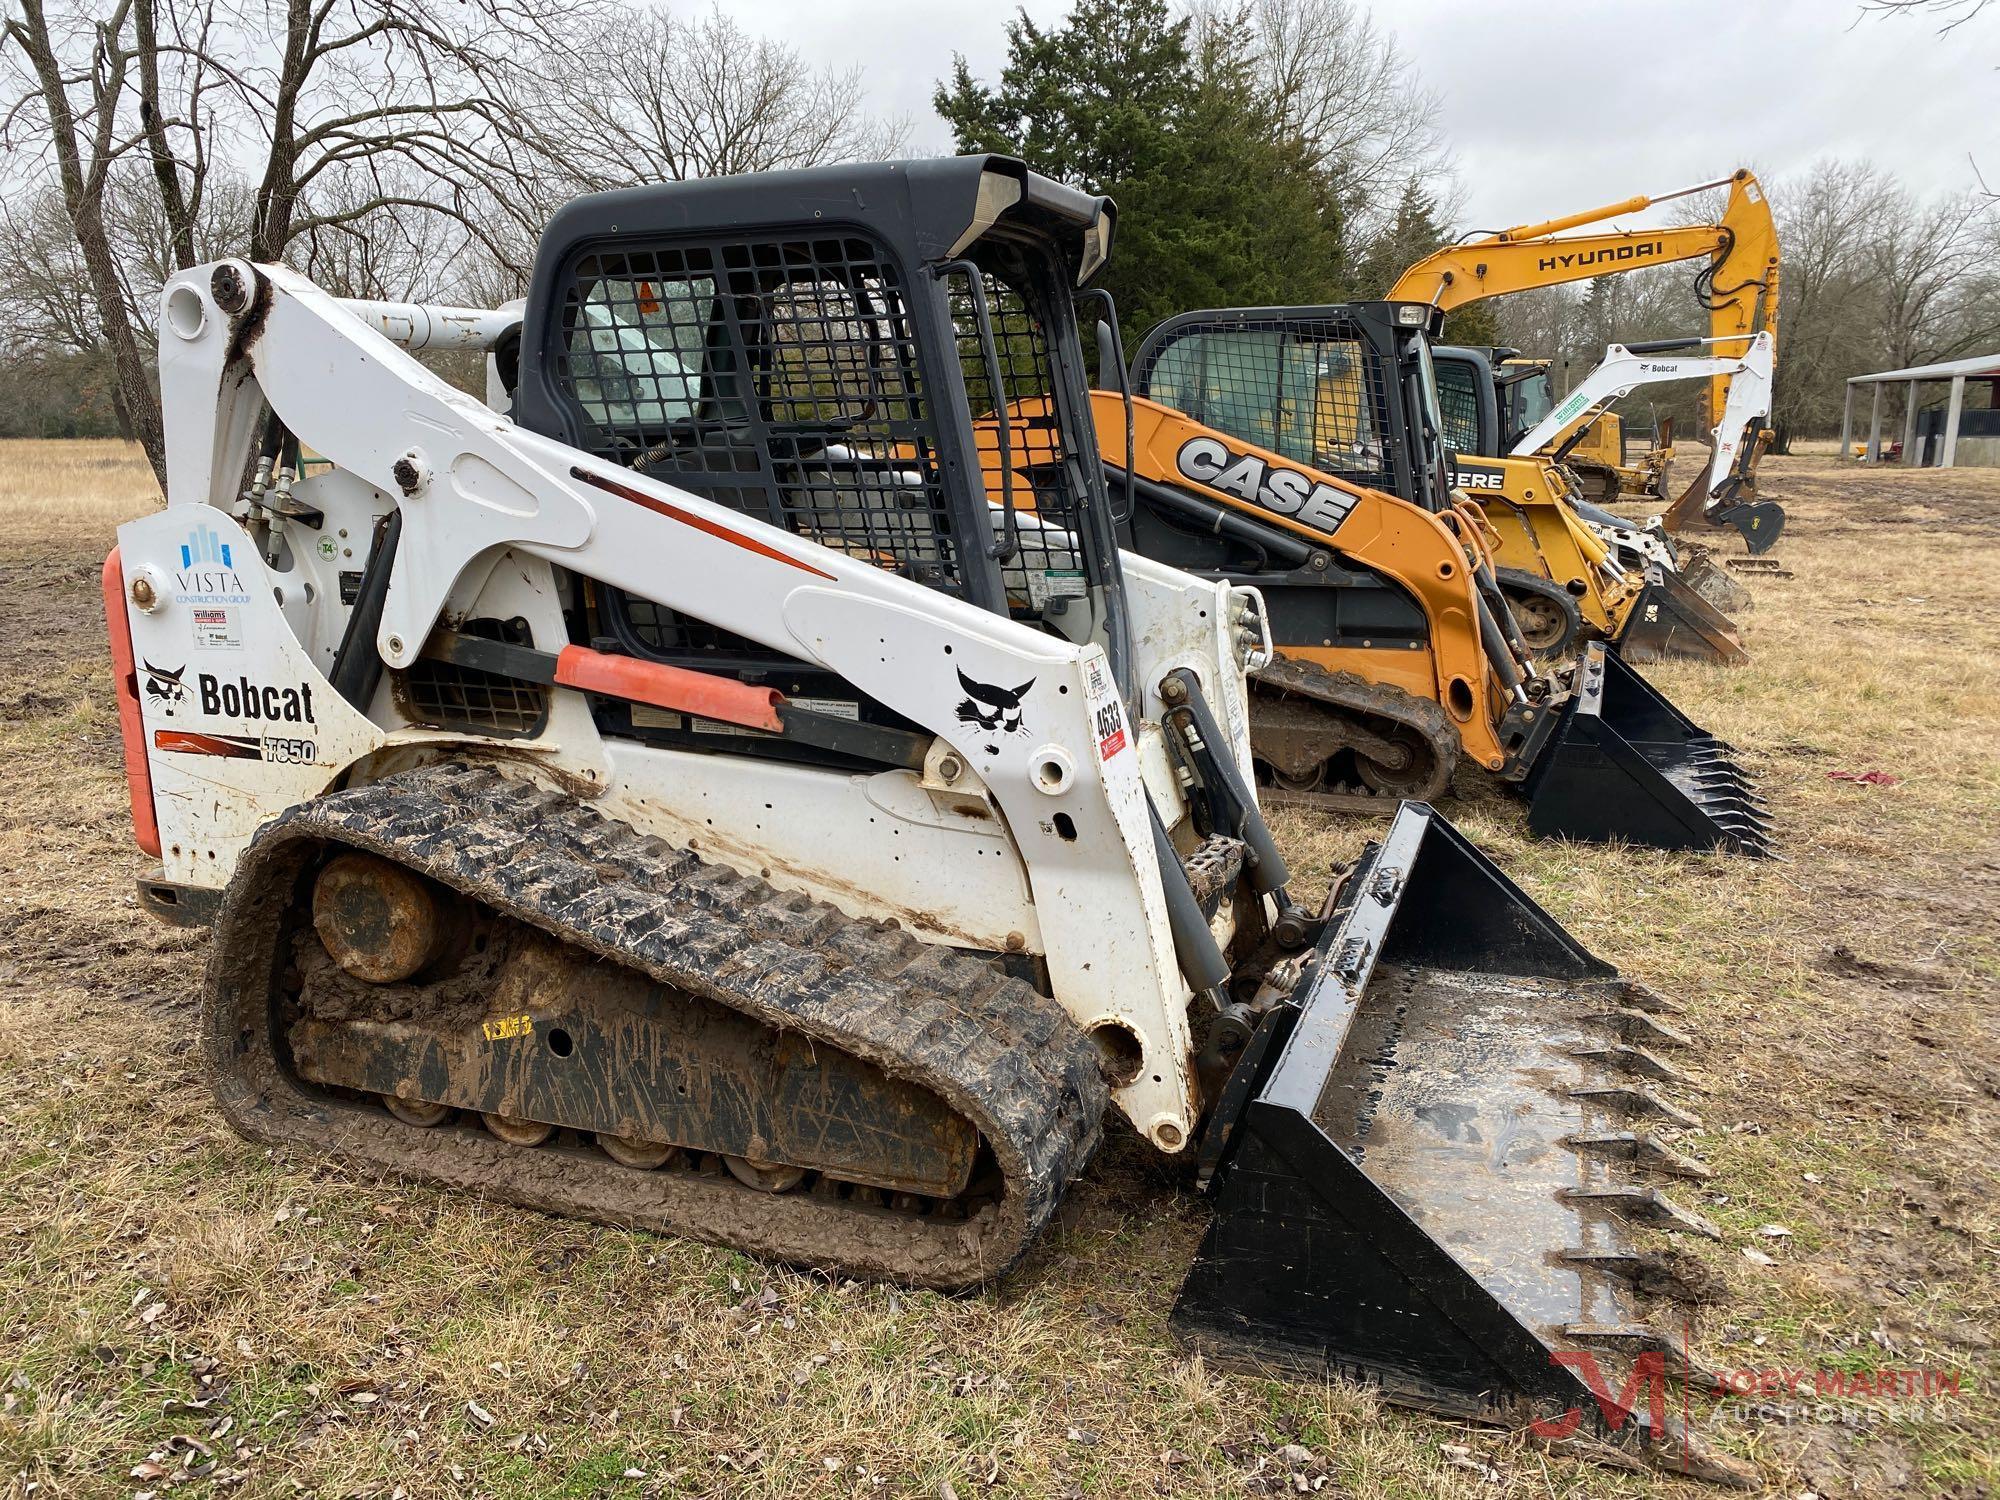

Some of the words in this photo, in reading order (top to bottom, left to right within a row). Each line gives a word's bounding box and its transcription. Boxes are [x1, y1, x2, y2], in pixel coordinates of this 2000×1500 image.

[1539, 242, 1663, 271] HYUNDAI
[1652, 364, 1678, 372] Bobcat
[1556, 395, 1586, 421] williams
[1179, 437, 1358, 532] CASE
[1447, 471, 1503, 489] ERE
[176, 572, 244, 592] VISTA
[176, 595, 227, 603] CONSTRUCTION
[229, 595, 251, 603] GROUP
[194, 610, 226, 618] williams
[199, 673, 315, 723] Bobcat
[1097, 700, 1122, 740] 4633
[264, 736, 316, 765] T650
